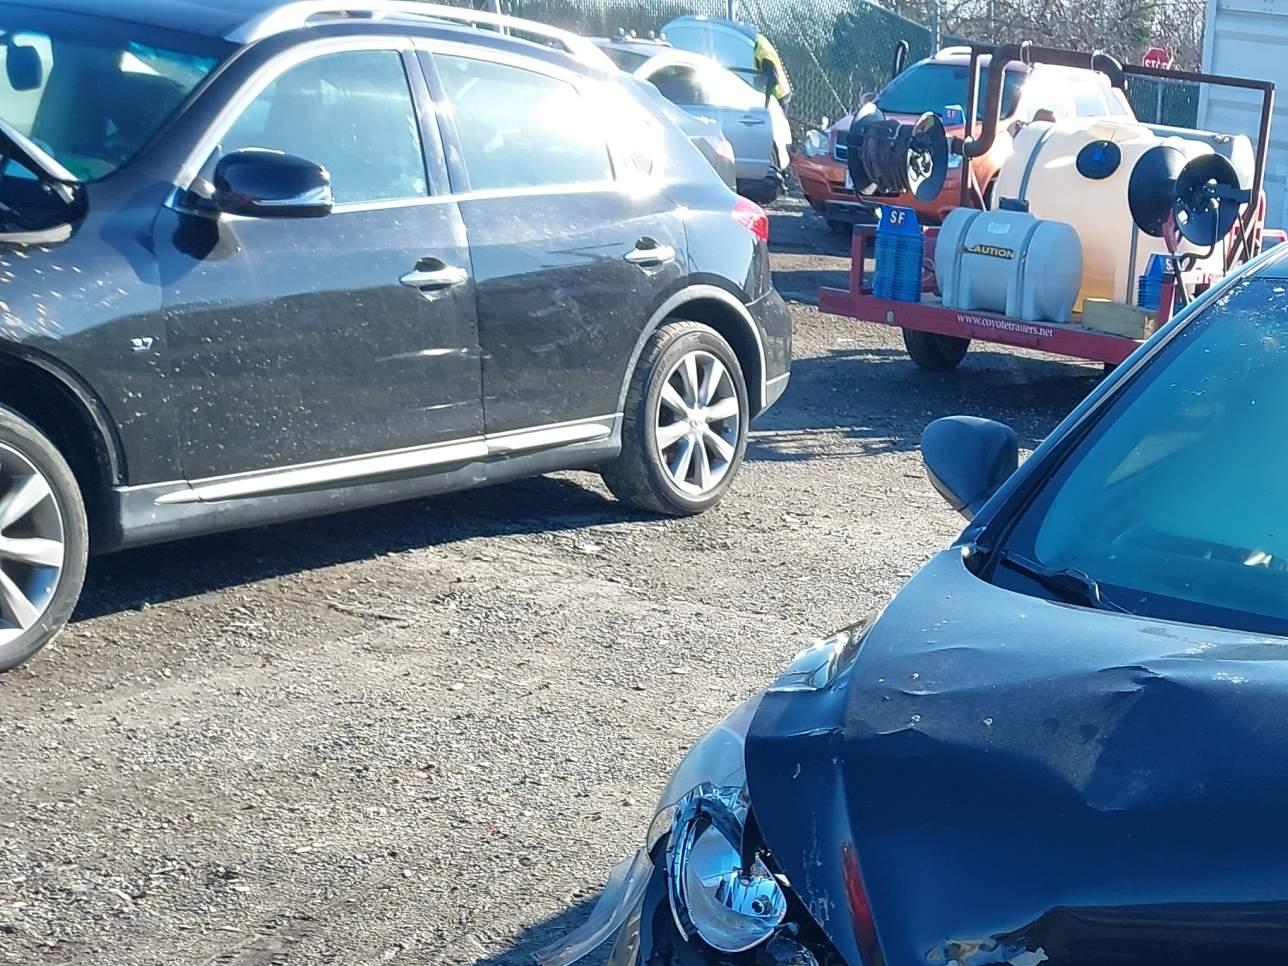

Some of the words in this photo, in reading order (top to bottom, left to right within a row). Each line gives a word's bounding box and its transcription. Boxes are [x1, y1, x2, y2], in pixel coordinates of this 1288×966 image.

[889, 210, 906, 225] SF
[967, 244, 1016, 260] CAUTION
[956, 312, 1054, 337] www.coyotetrailers.net
